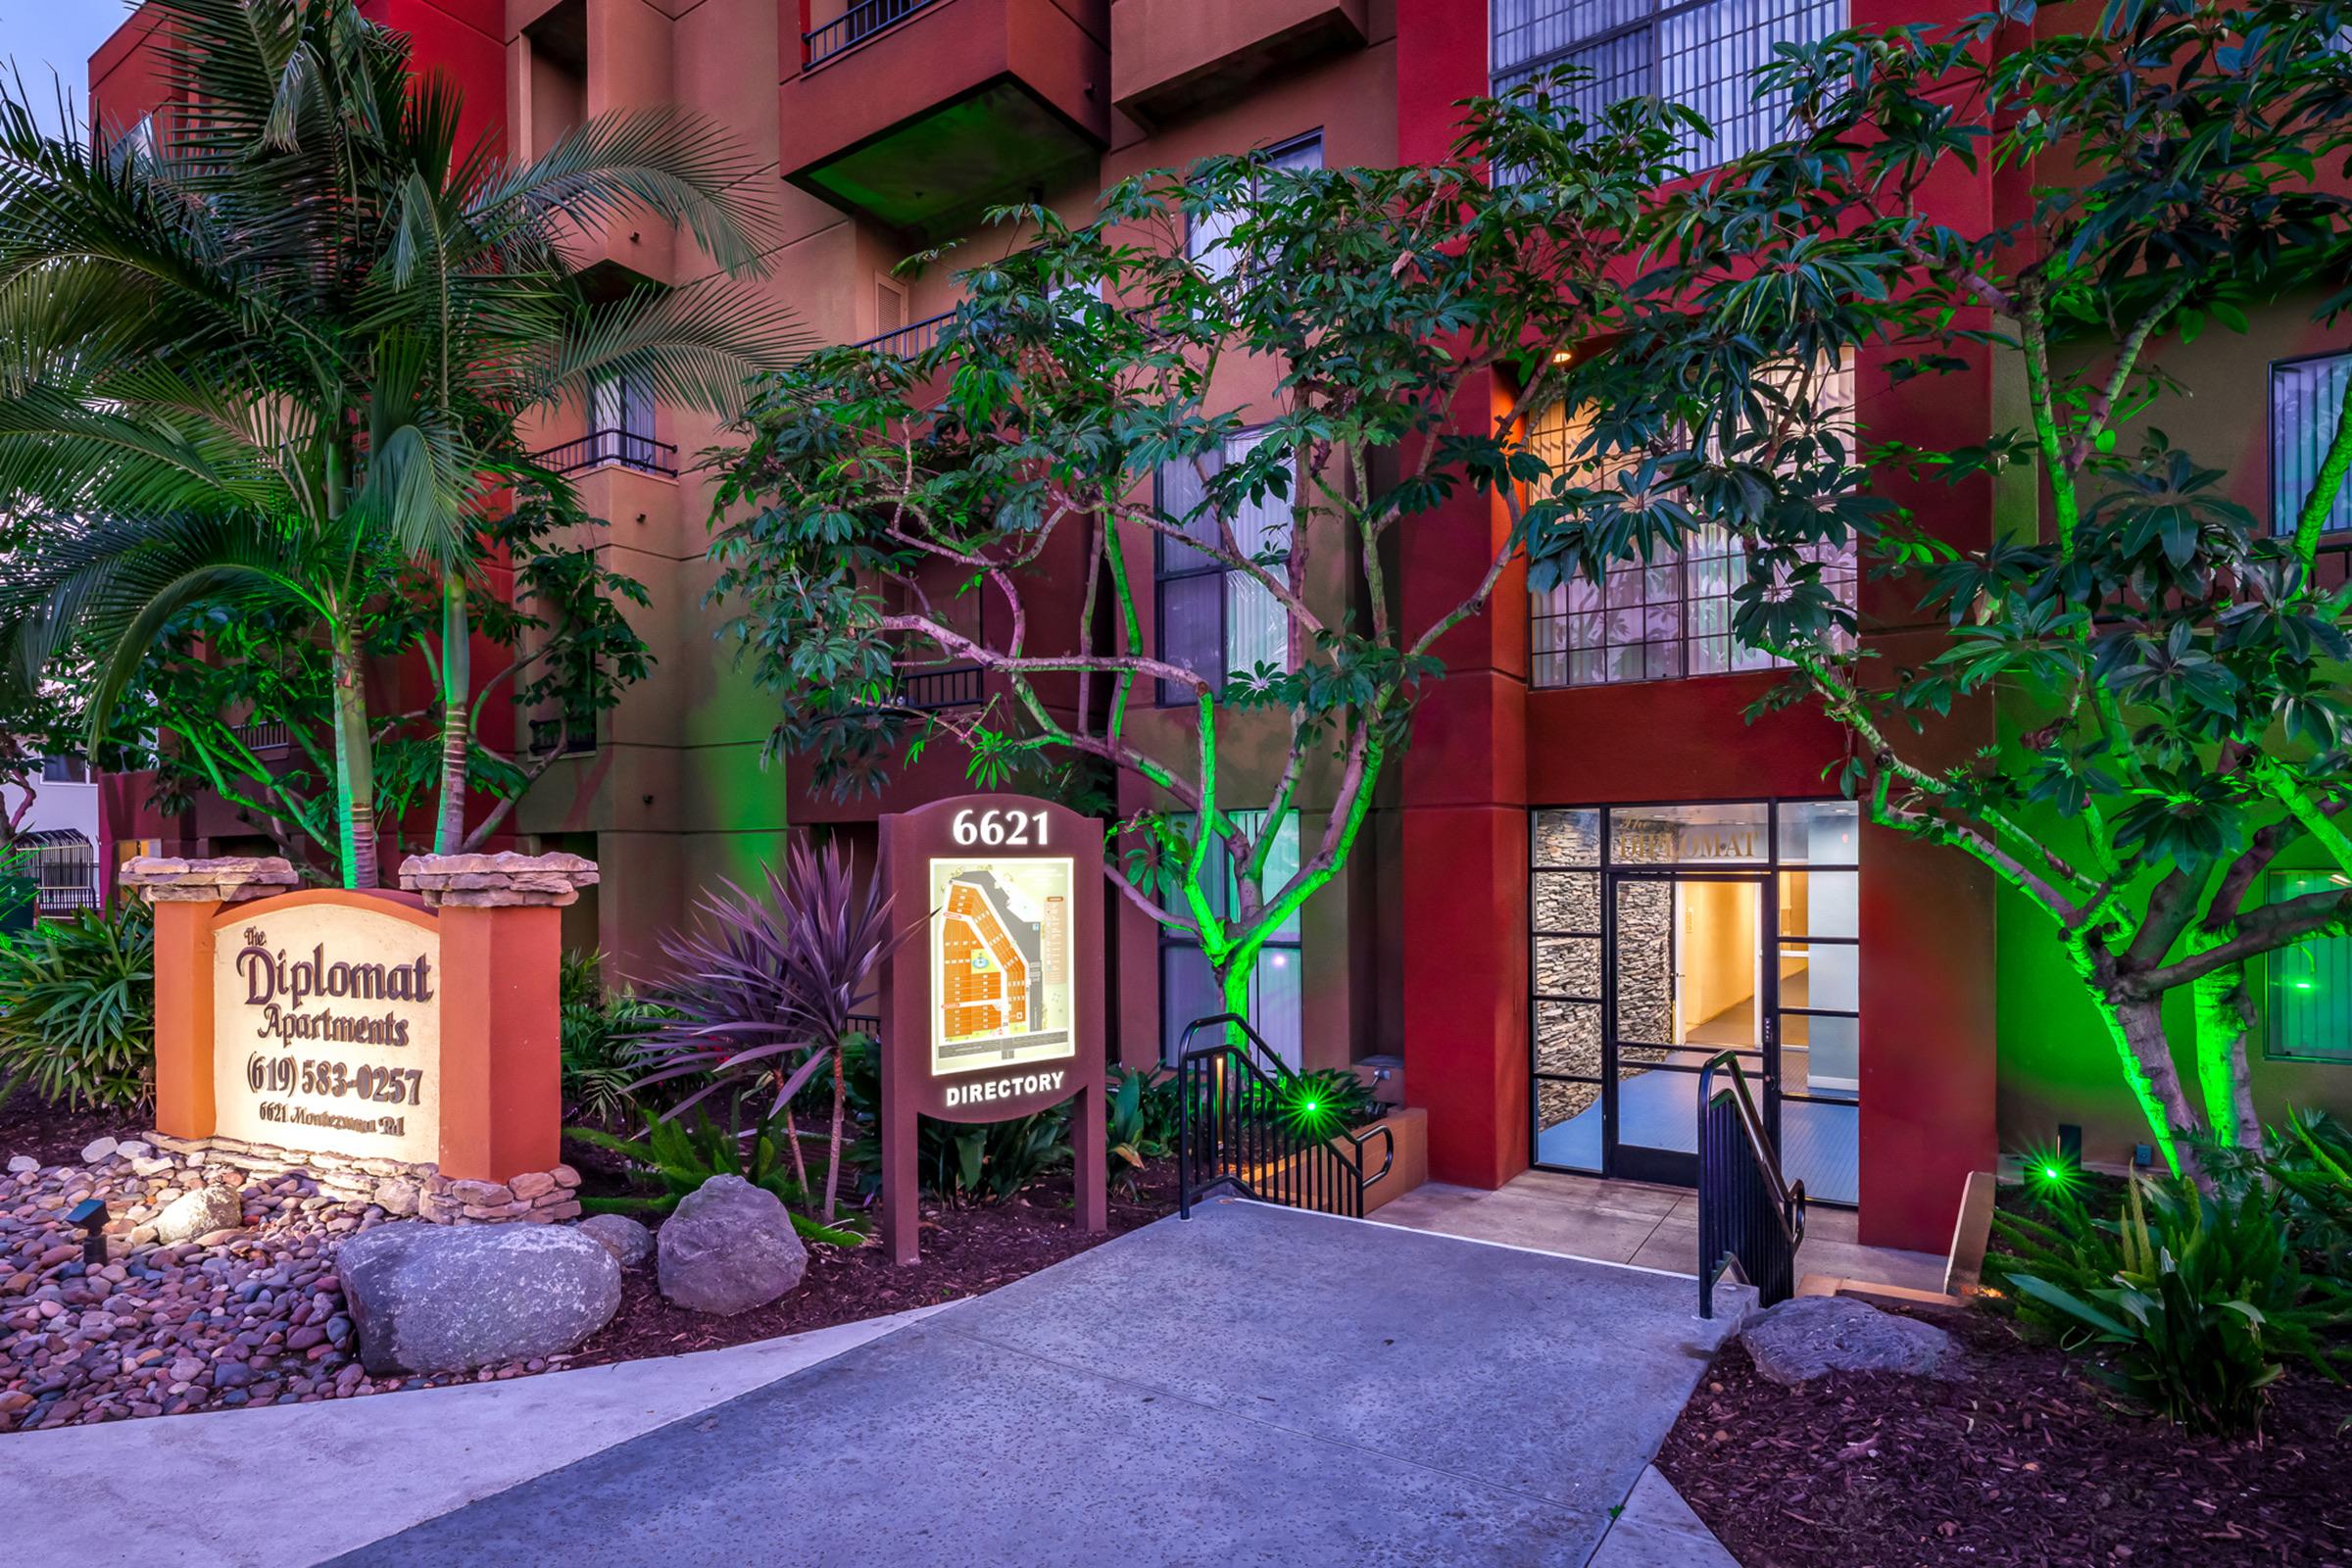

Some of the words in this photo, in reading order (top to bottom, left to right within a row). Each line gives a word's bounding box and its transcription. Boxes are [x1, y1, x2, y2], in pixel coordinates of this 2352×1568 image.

[953, 808, 1049, 846] 6621
[1620, 831, 1760, 858] DIPLOMAT
[244, 926, 267, 947] The
[236, 942, 434, 1010] Diplomat
[257, 1004, 410, 1048] Apartments
[247, 1051, 298, 1098] (619)
[302, 1059, 423, 1105] 583-0257
[947, 1071, 1065, 1106] DIRECTORY
[259, 1101, 288, 1123] 6621
[378, 1116, 405, 1137] Rd
